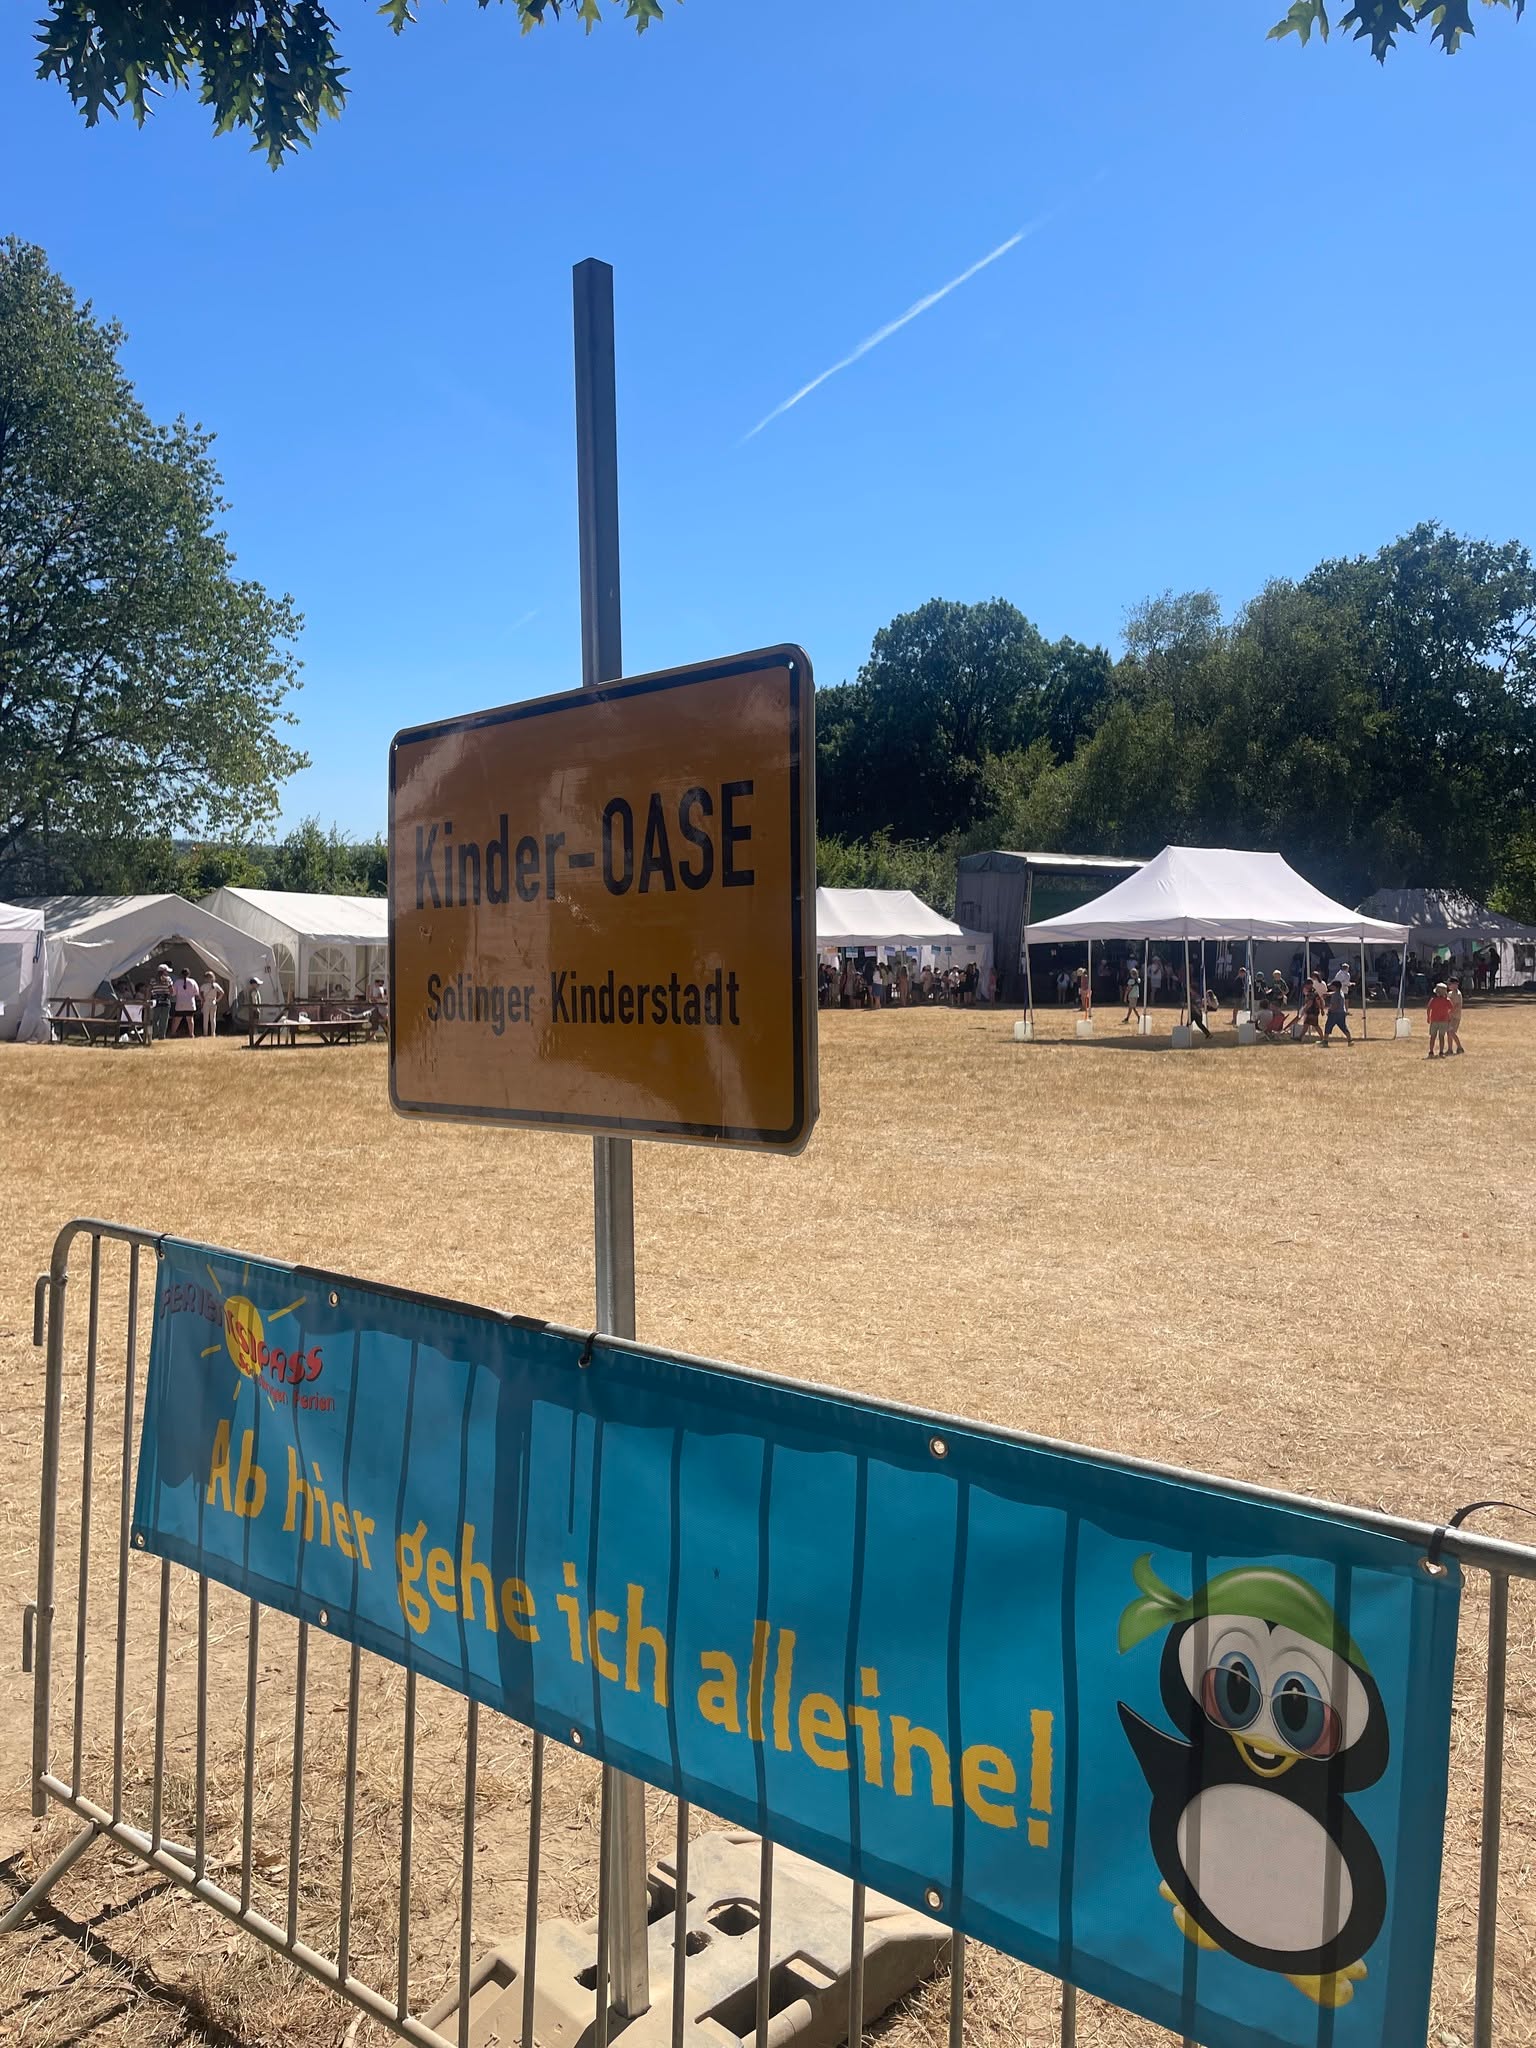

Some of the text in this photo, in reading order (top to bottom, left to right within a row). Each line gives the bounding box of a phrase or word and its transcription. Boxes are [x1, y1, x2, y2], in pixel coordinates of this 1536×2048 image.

[415, 780, 755, 909] Kinder-OASE
[427, 968, 740, 1036] Solinger Kinderstadt
[205, 1418, 1055, 1848] Ab hier gehe ich alleine!
